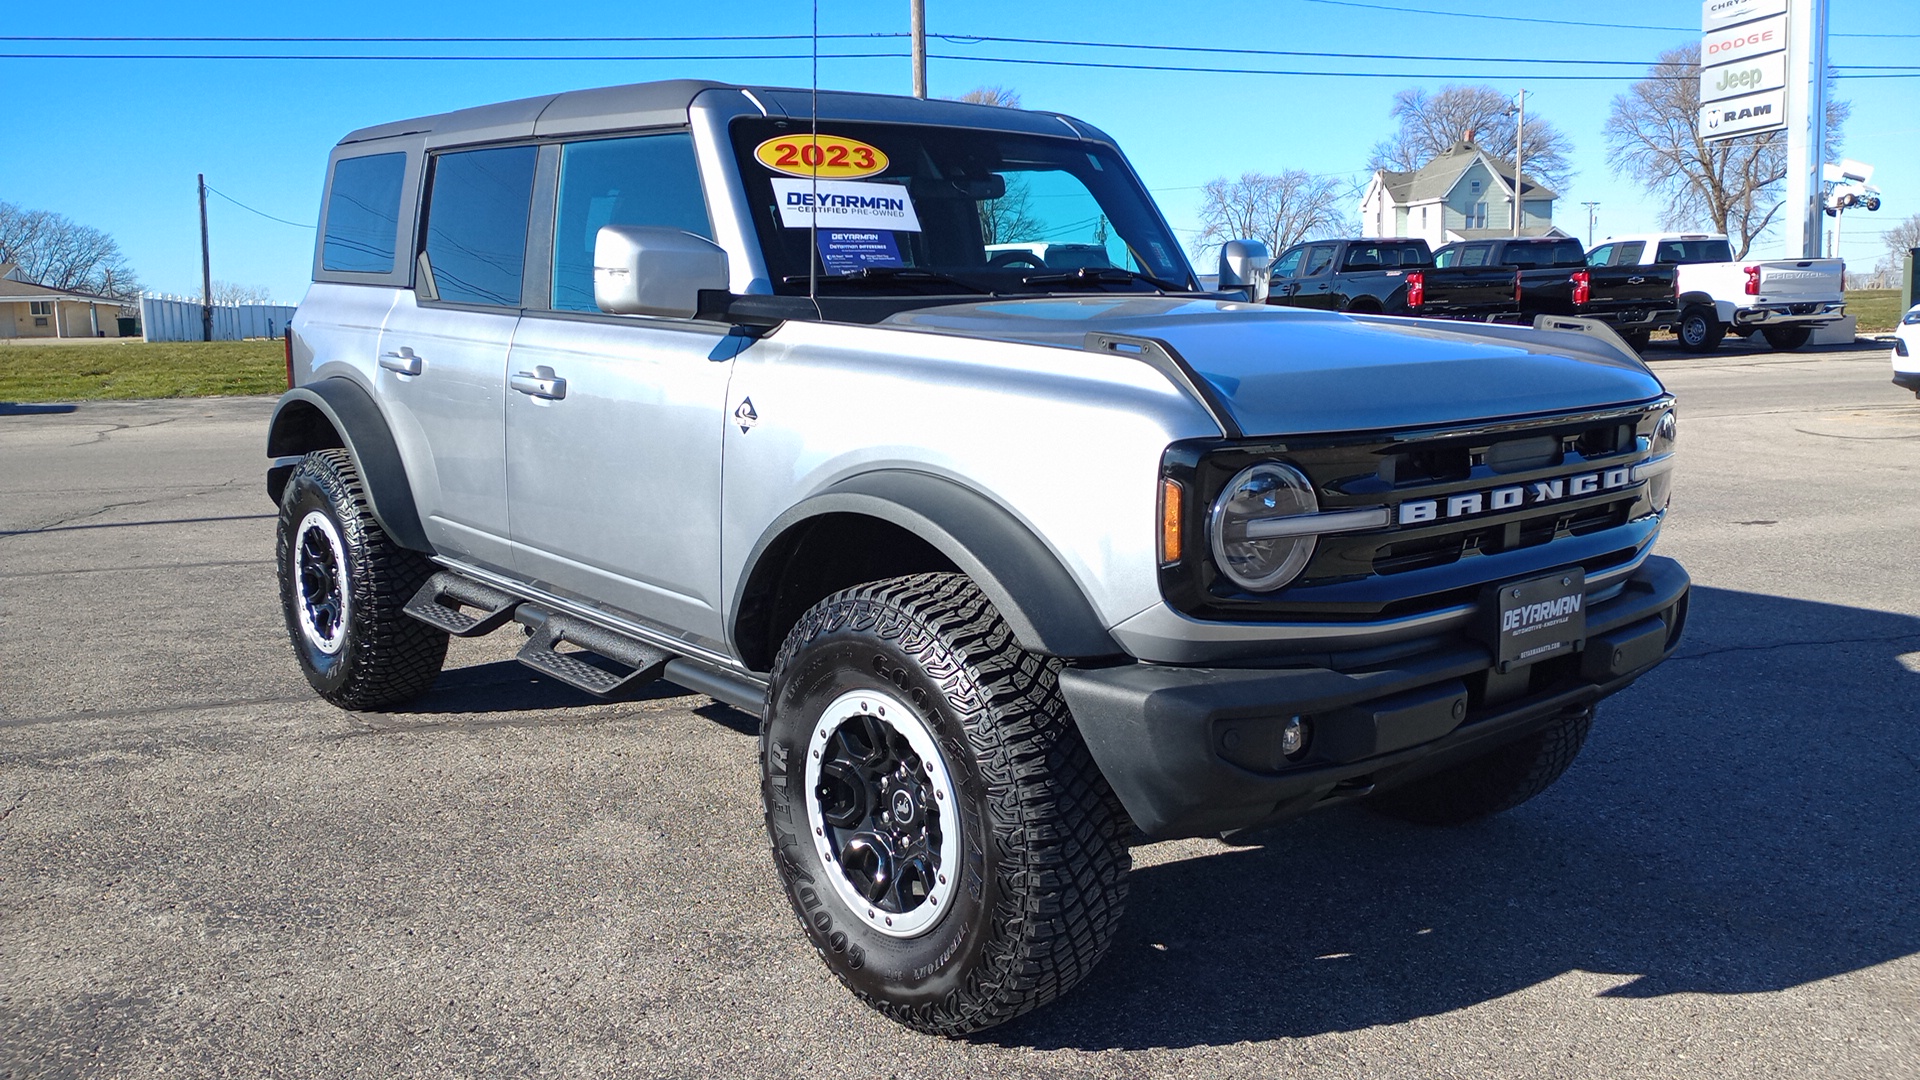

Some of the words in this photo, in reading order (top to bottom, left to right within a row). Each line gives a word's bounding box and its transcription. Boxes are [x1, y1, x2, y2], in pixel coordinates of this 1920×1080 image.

[1711, 0, 1751, 11] CHRYS
[1708, 30, 1773, 54] DODGE
[1716, 68, 1762, 91] Jeep
[1723, 104, 1772, 122] RAM
[774, 143, 877, 169] 2023
[786, 192, 904, 211] DEYARMAN
[797, 206, 848, 215] CERTIFIED
[851, 208, 905, 218] PRE-OWNED
[1766, 272, 1833, 280] CHEVROL
[1398, 467, 1630, 525] BRONCO
[1502, 594, 1582, 632] DEYARMAN
[770, 740, 868, 971] GOODYEAR
